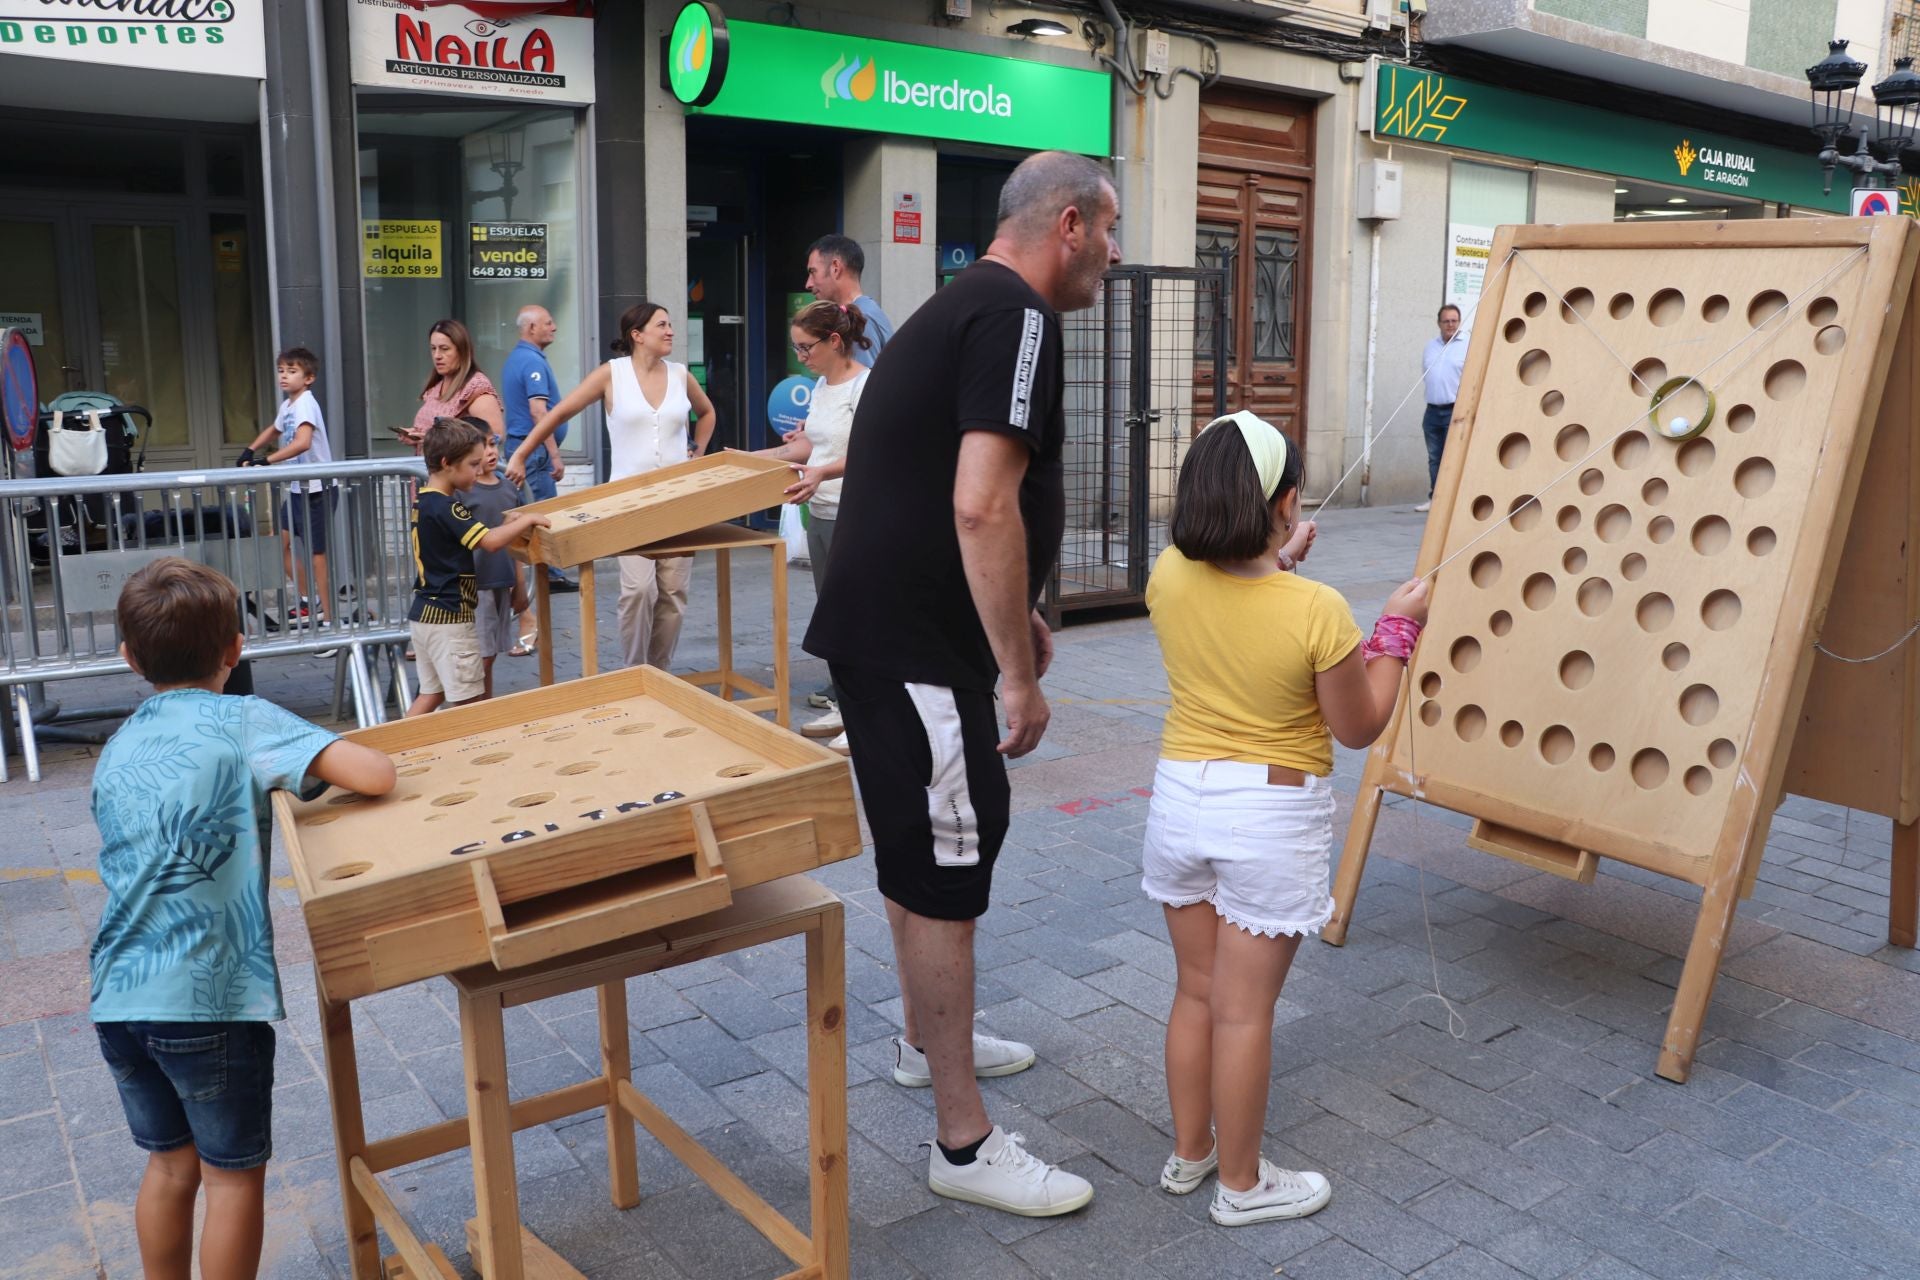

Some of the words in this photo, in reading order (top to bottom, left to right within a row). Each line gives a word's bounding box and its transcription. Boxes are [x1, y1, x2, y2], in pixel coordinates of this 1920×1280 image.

[0, 21, 225, 46] Deportes
[461, 69, 561, 87] PERSONALIZADOS
[508, 86, 545, 96] Arnedo
[884, 70, 1011, 117] Iberdrola
[1699, 147, 1723, 167] CAJA
[1724, 152, 1756, 173] RURAL
[1703, 168, 1715, 182] DE
[1716, 172, 1749, 188] ARAGÓN
[382, 224, 438, 234] ESPUELAS
[489, 226, 545, 237] ESPUELAS
[371, 244, 433, 263] alquila
[480, 247, 539, 263] vende
[366, 265, 389, 275] 648
[391, 265, 406, 275] 20
[408, 265, 422, 275] 58
[424, 265, 439, 275] 99
[472, 266, 496, 277] 648
[496, 267, 512, 277] 20
[513, 267, 529, 277] 58
[530, 267, 546, 278] 99
